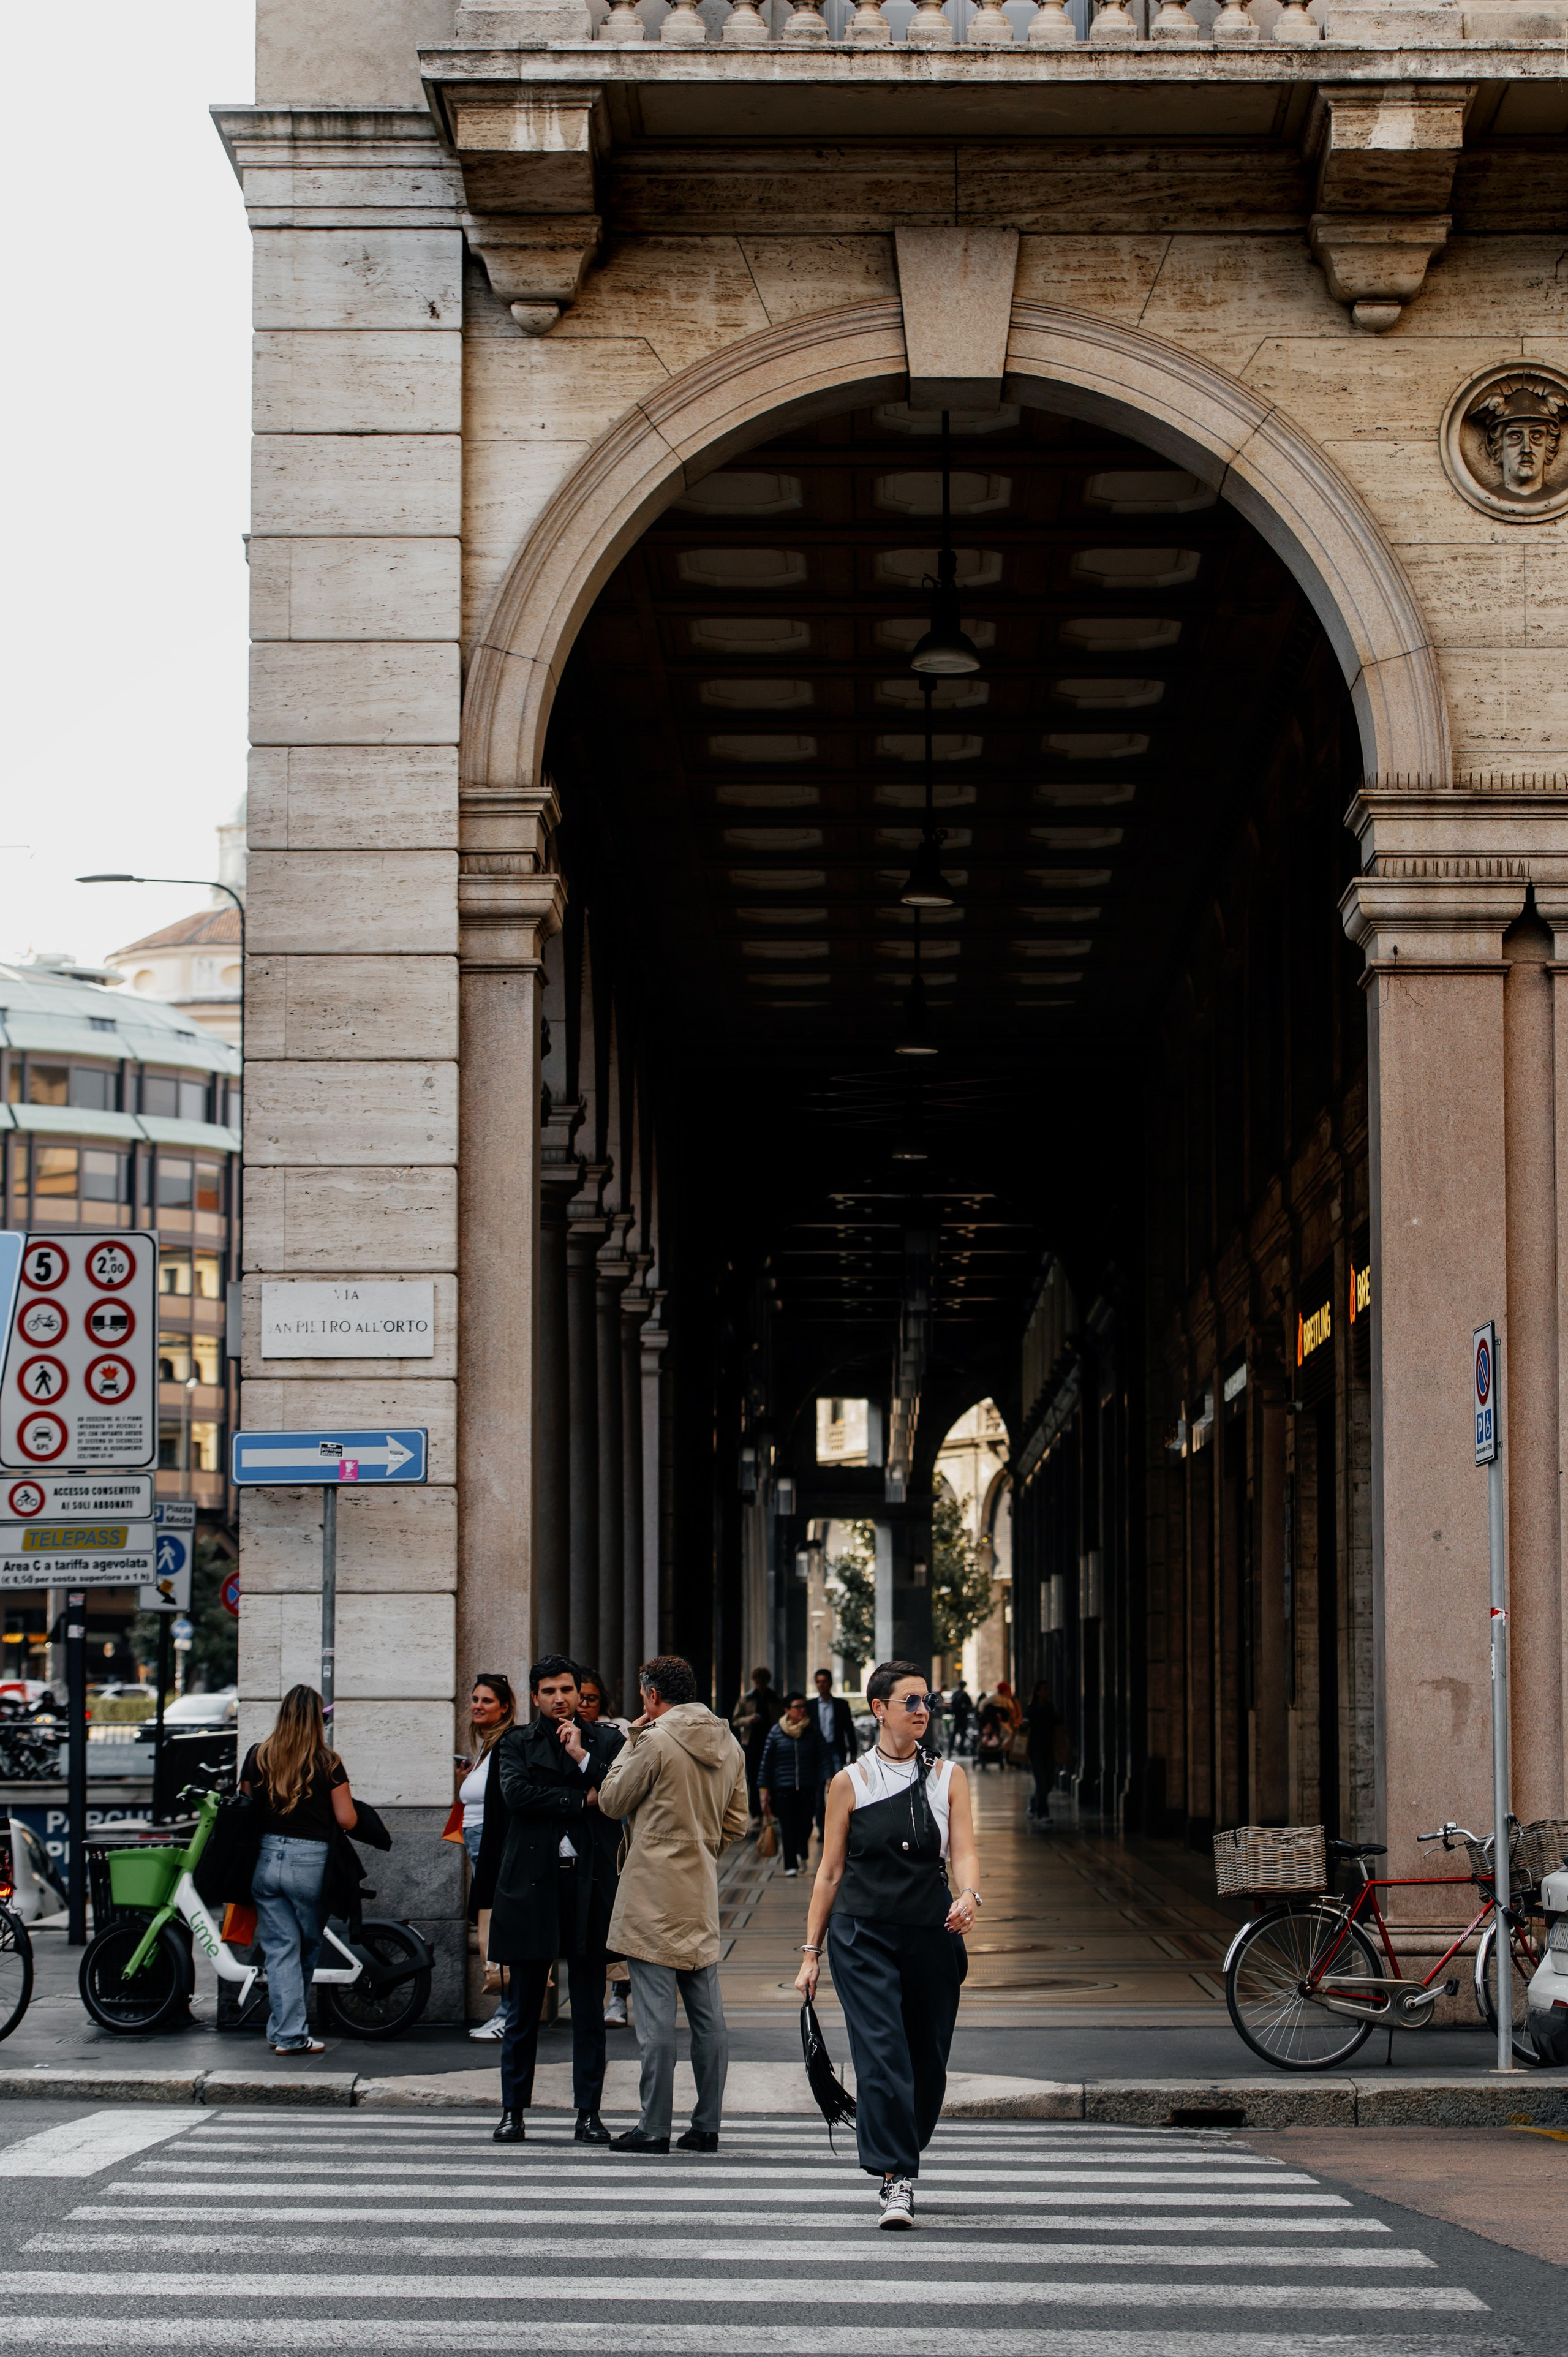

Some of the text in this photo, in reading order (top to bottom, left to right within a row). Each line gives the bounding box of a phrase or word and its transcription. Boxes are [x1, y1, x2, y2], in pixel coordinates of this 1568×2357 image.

[34, 1252, 51, 1281] 5
[296, 1320, 351, 1333] PIETRO
[355, 1319, 428, 1333] ALL'ORTO
[1303, 1300, 1331, 1357] BREITLING
[53, 1486, 141, 1496] ACCESSO CONSENTITO
[72, 1501, 91, 1509] SOLI
[93, 1500, 133, 1509] ABBONATI
[29, 1529, 121, 1547] TELEPASS
[3, 1558, 148, 1572] Area C a tariffa agevolata
[79, 1574, 121, 1583] superiore
[190, 1910, 219, 1959] Lime
